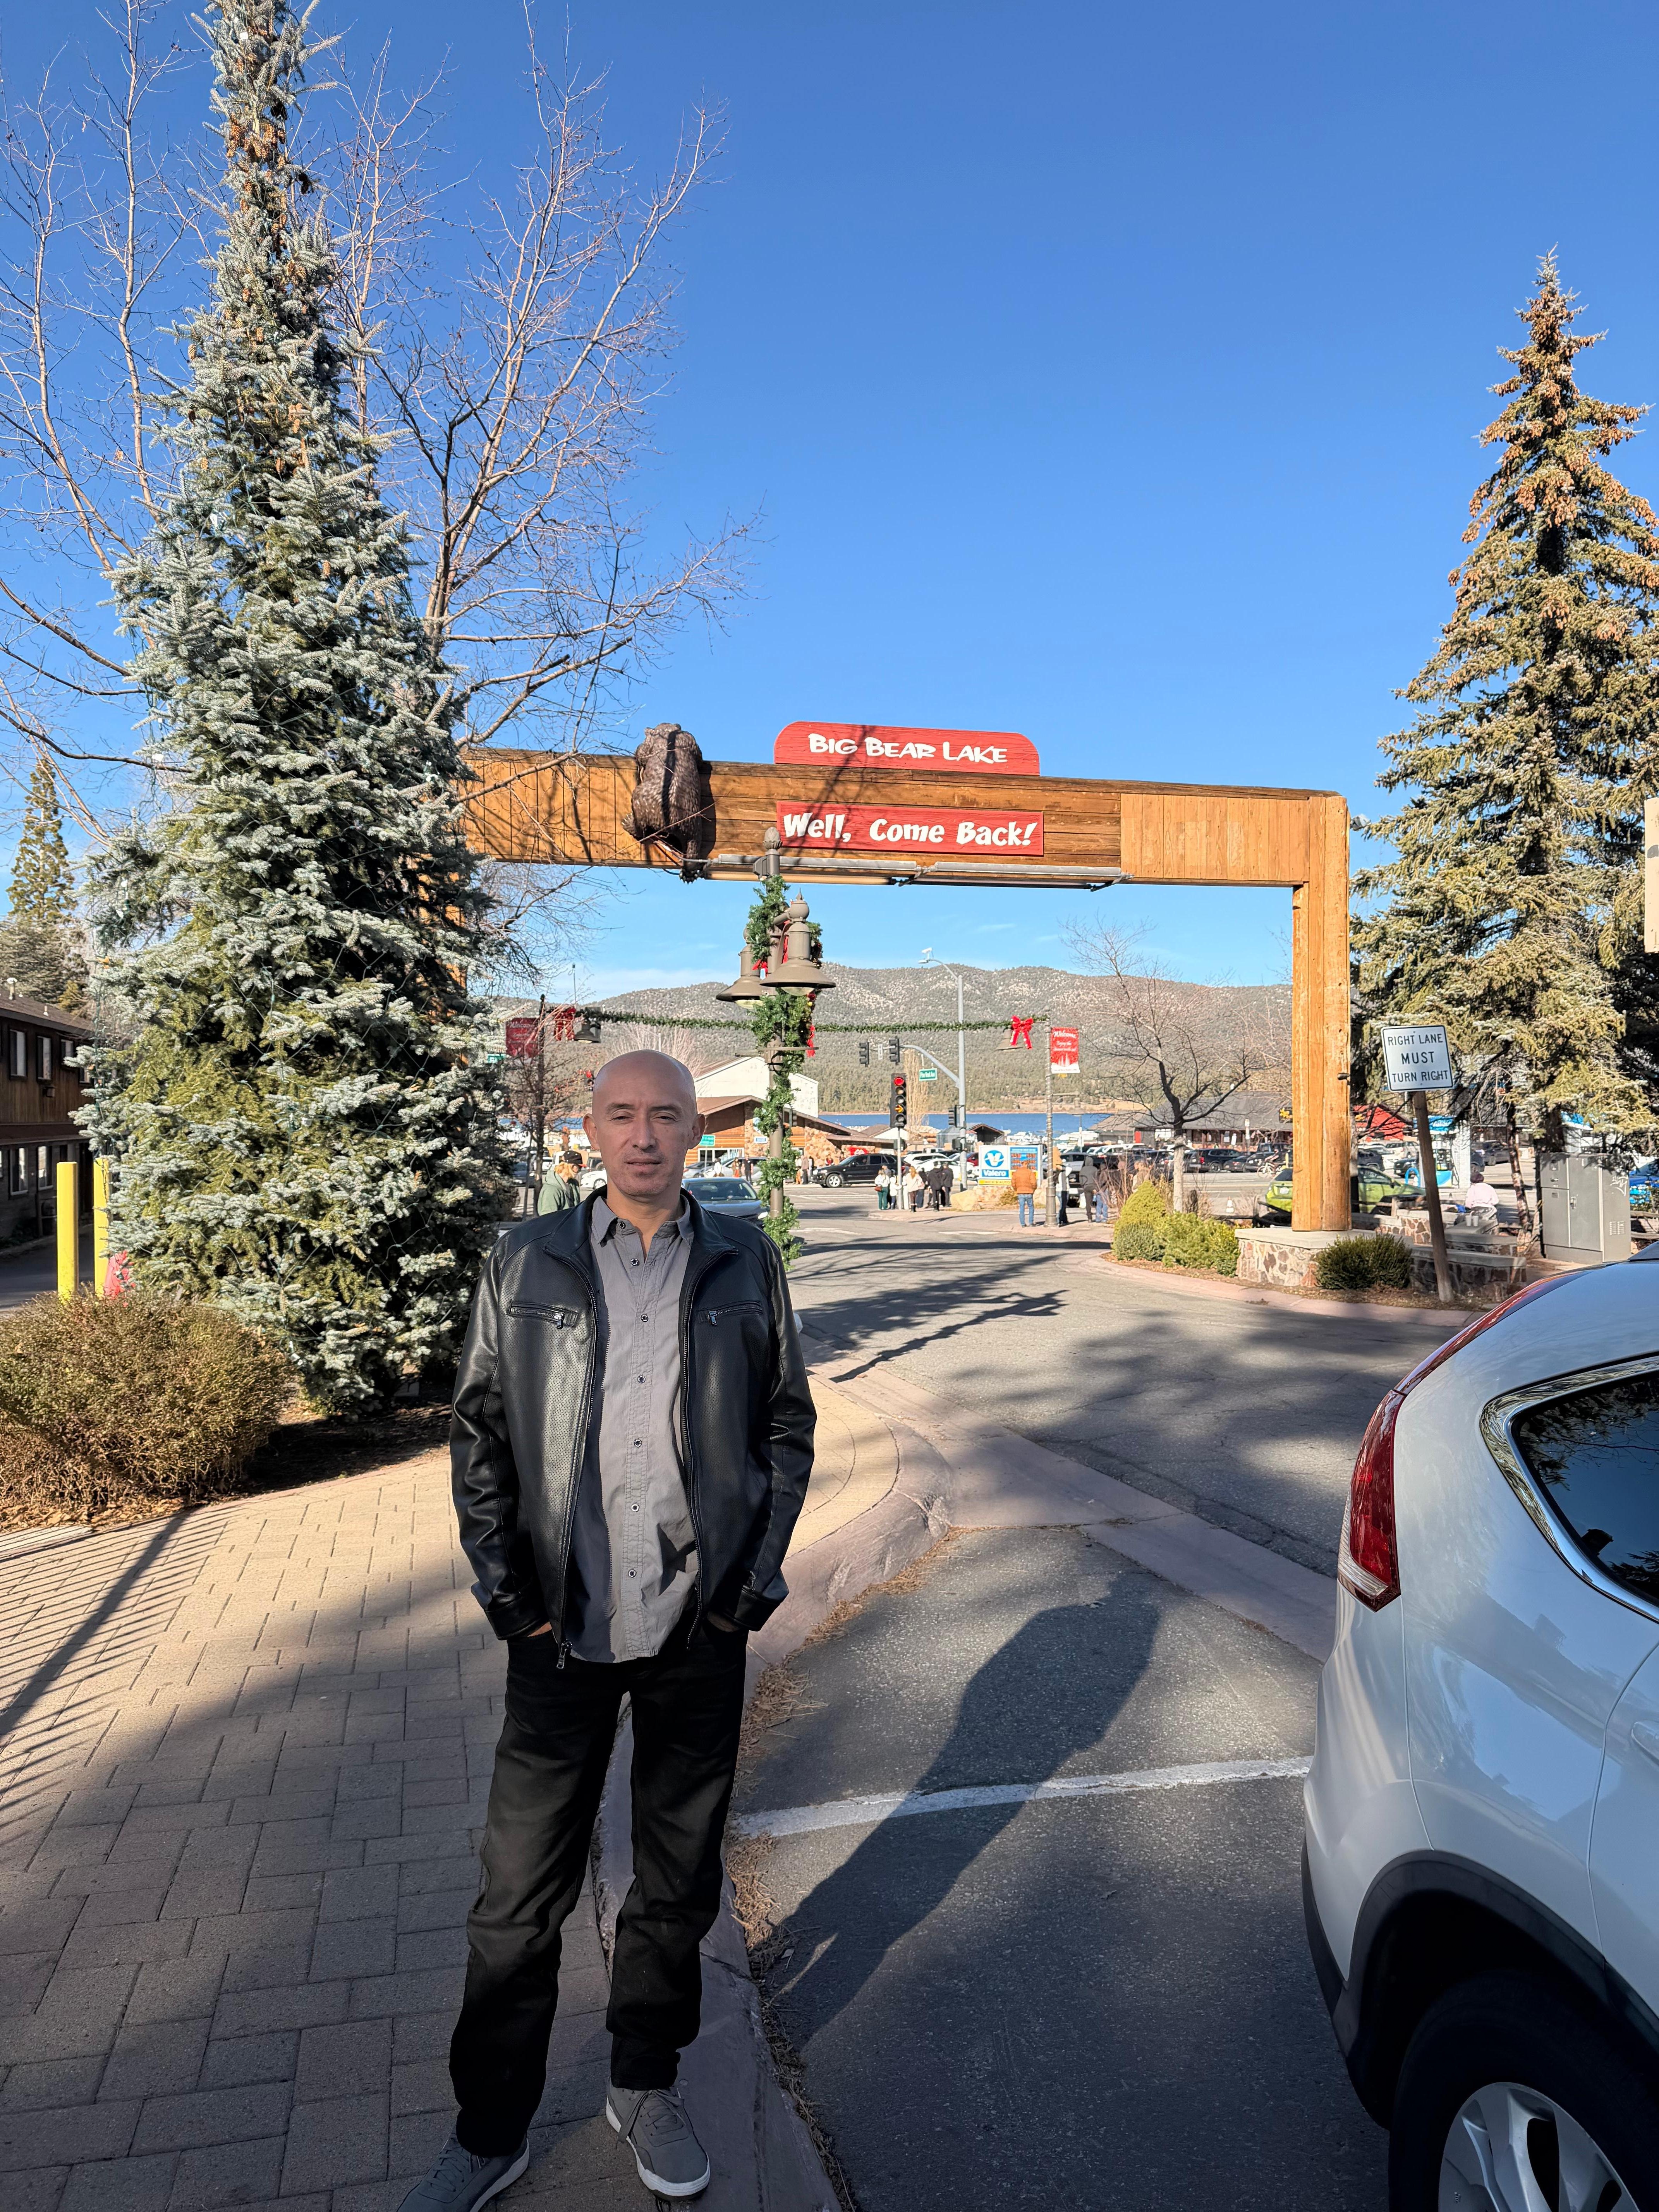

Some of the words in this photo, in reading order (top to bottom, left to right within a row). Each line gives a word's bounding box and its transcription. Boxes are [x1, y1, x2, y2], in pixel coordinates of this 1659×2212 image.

[808, 733, 858, 754] BIG
[864, 737, 936, 759] BEAR
[943, 741, 1008, 764] LAKE
[783, 812, 852, 842] Well,
[869, 818, 945, 843] Come
[956, 821, 1038, 846] Back!
[1388, 1035, 1415, 1045] RIGHT
[1419, 1034, 1443, 1044] LANE
[1401, 1051, 1434, 1064] MUST
[1392, 1072, 1417, 1082] TURN
[1421, 1070, 1448, 1081] RIGHT
